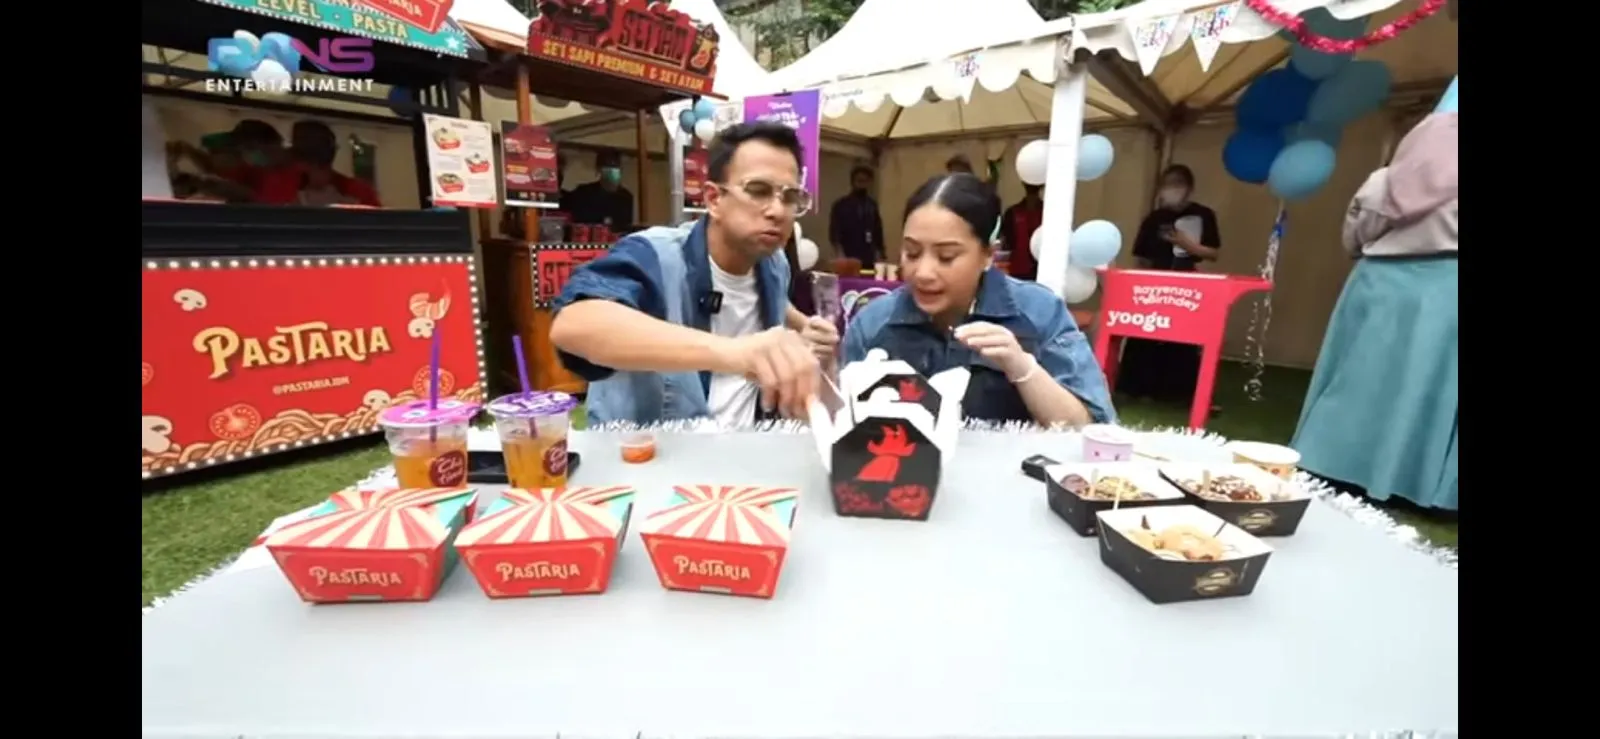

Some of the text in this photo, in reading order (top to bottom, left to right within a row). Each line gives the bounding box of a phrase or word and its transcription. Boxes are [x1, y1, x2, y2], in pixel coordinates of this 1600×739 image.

[352, 12, 408, 38] PASTA
[568, 46, 595, 65] SAPI
[596, 52, 645, 78] PREMIUM
[1106, 310, 1171, 332] yoogu
